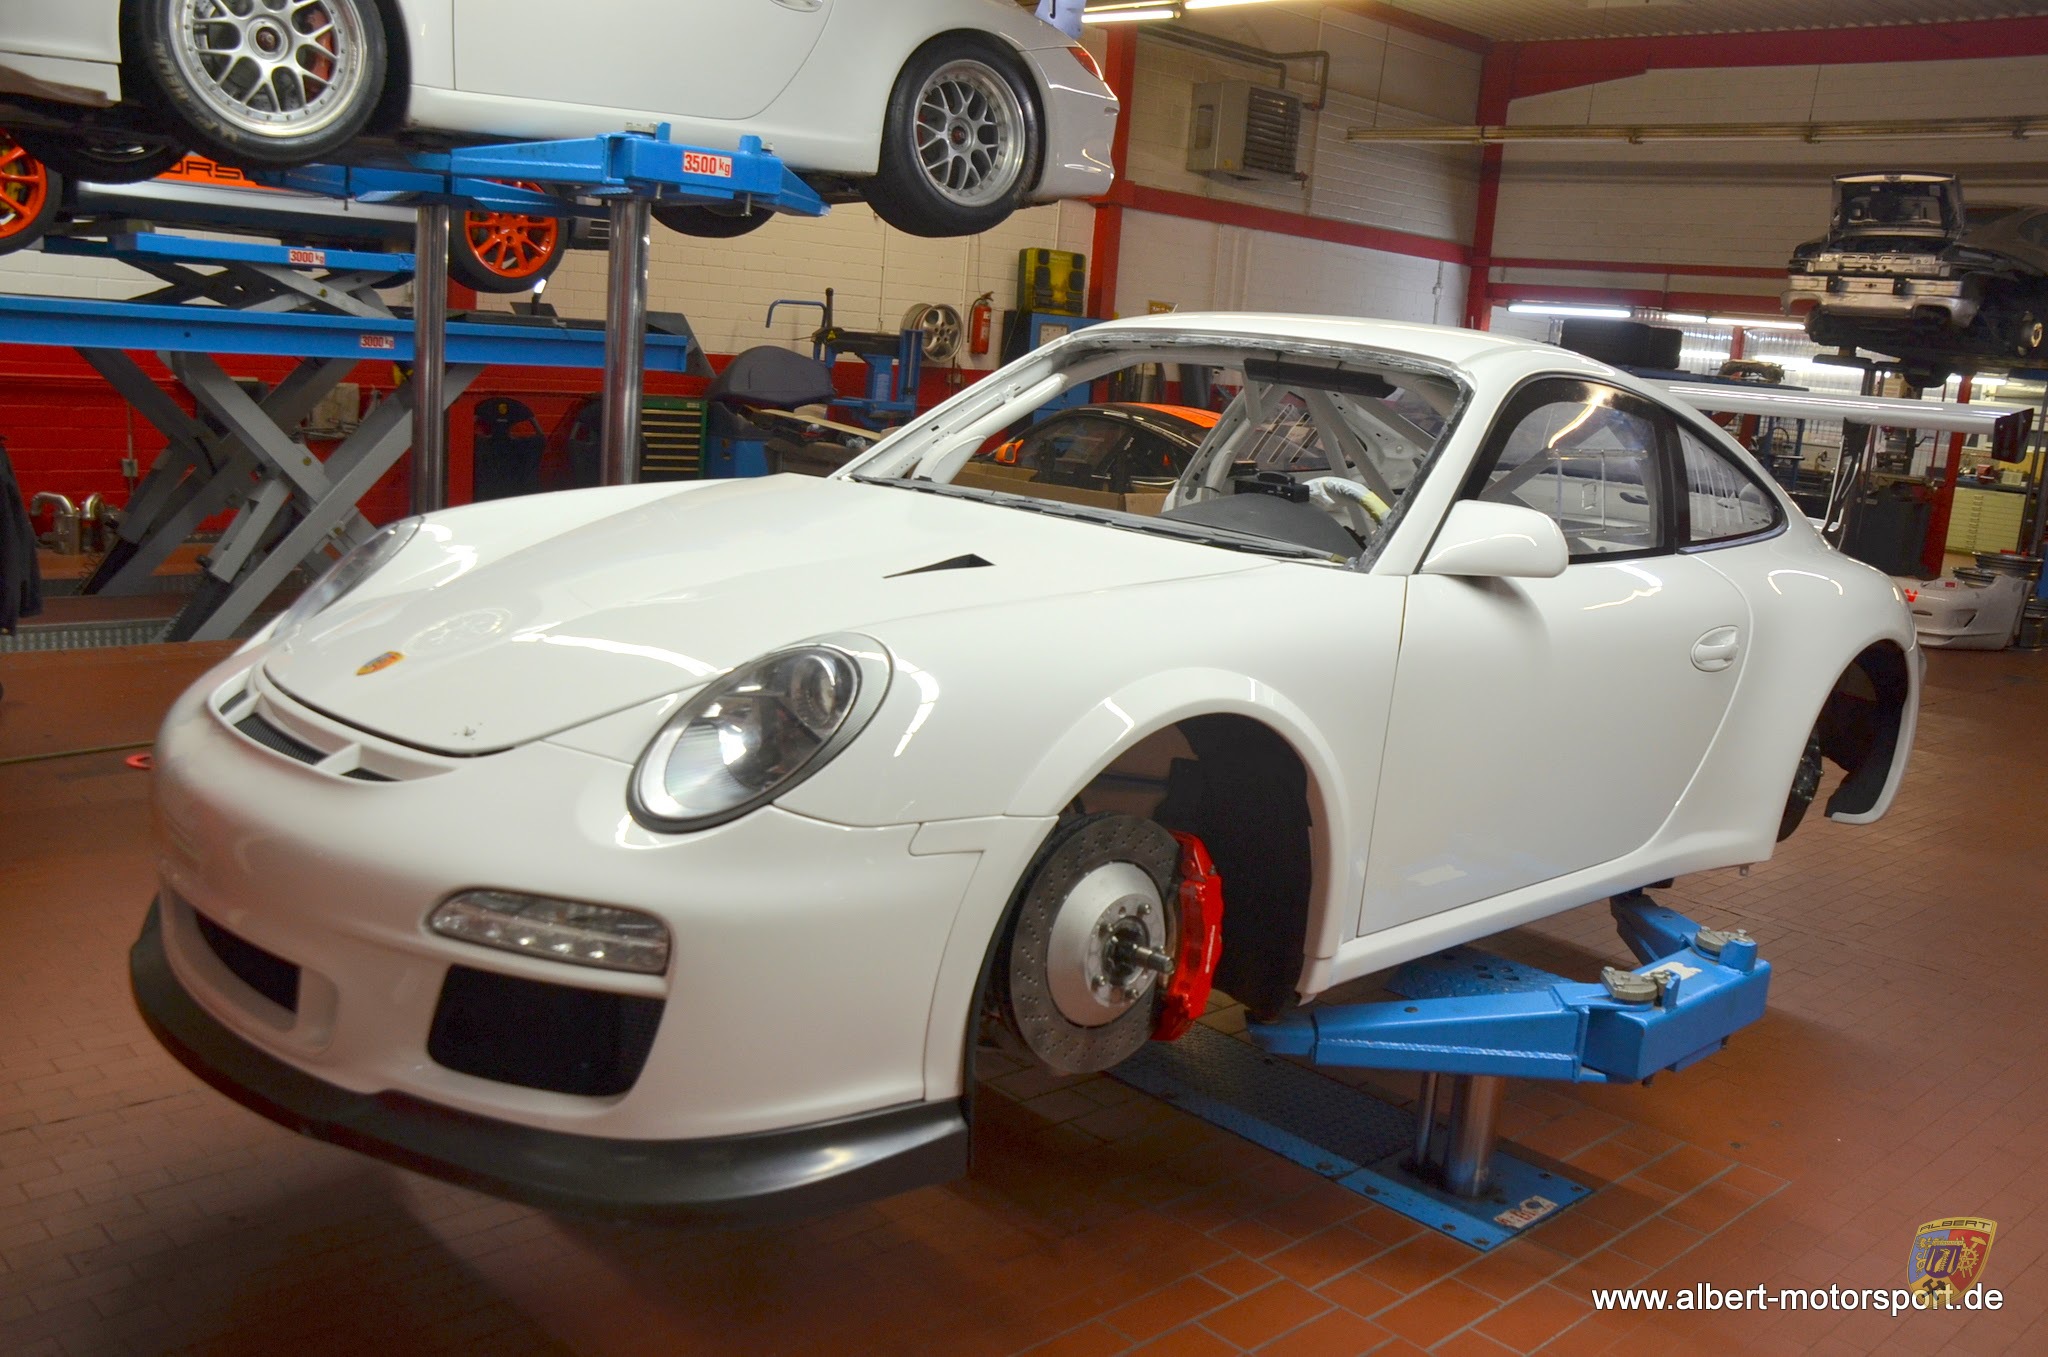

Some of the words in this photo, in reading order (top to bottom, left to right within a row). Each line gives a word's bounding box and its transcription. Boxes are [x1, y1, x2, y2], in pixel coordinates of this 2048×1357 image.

[684, 153, 717, 174] 3500
[718, 157, 731, 177] kg
[290, 250, 314, 263] 3000
